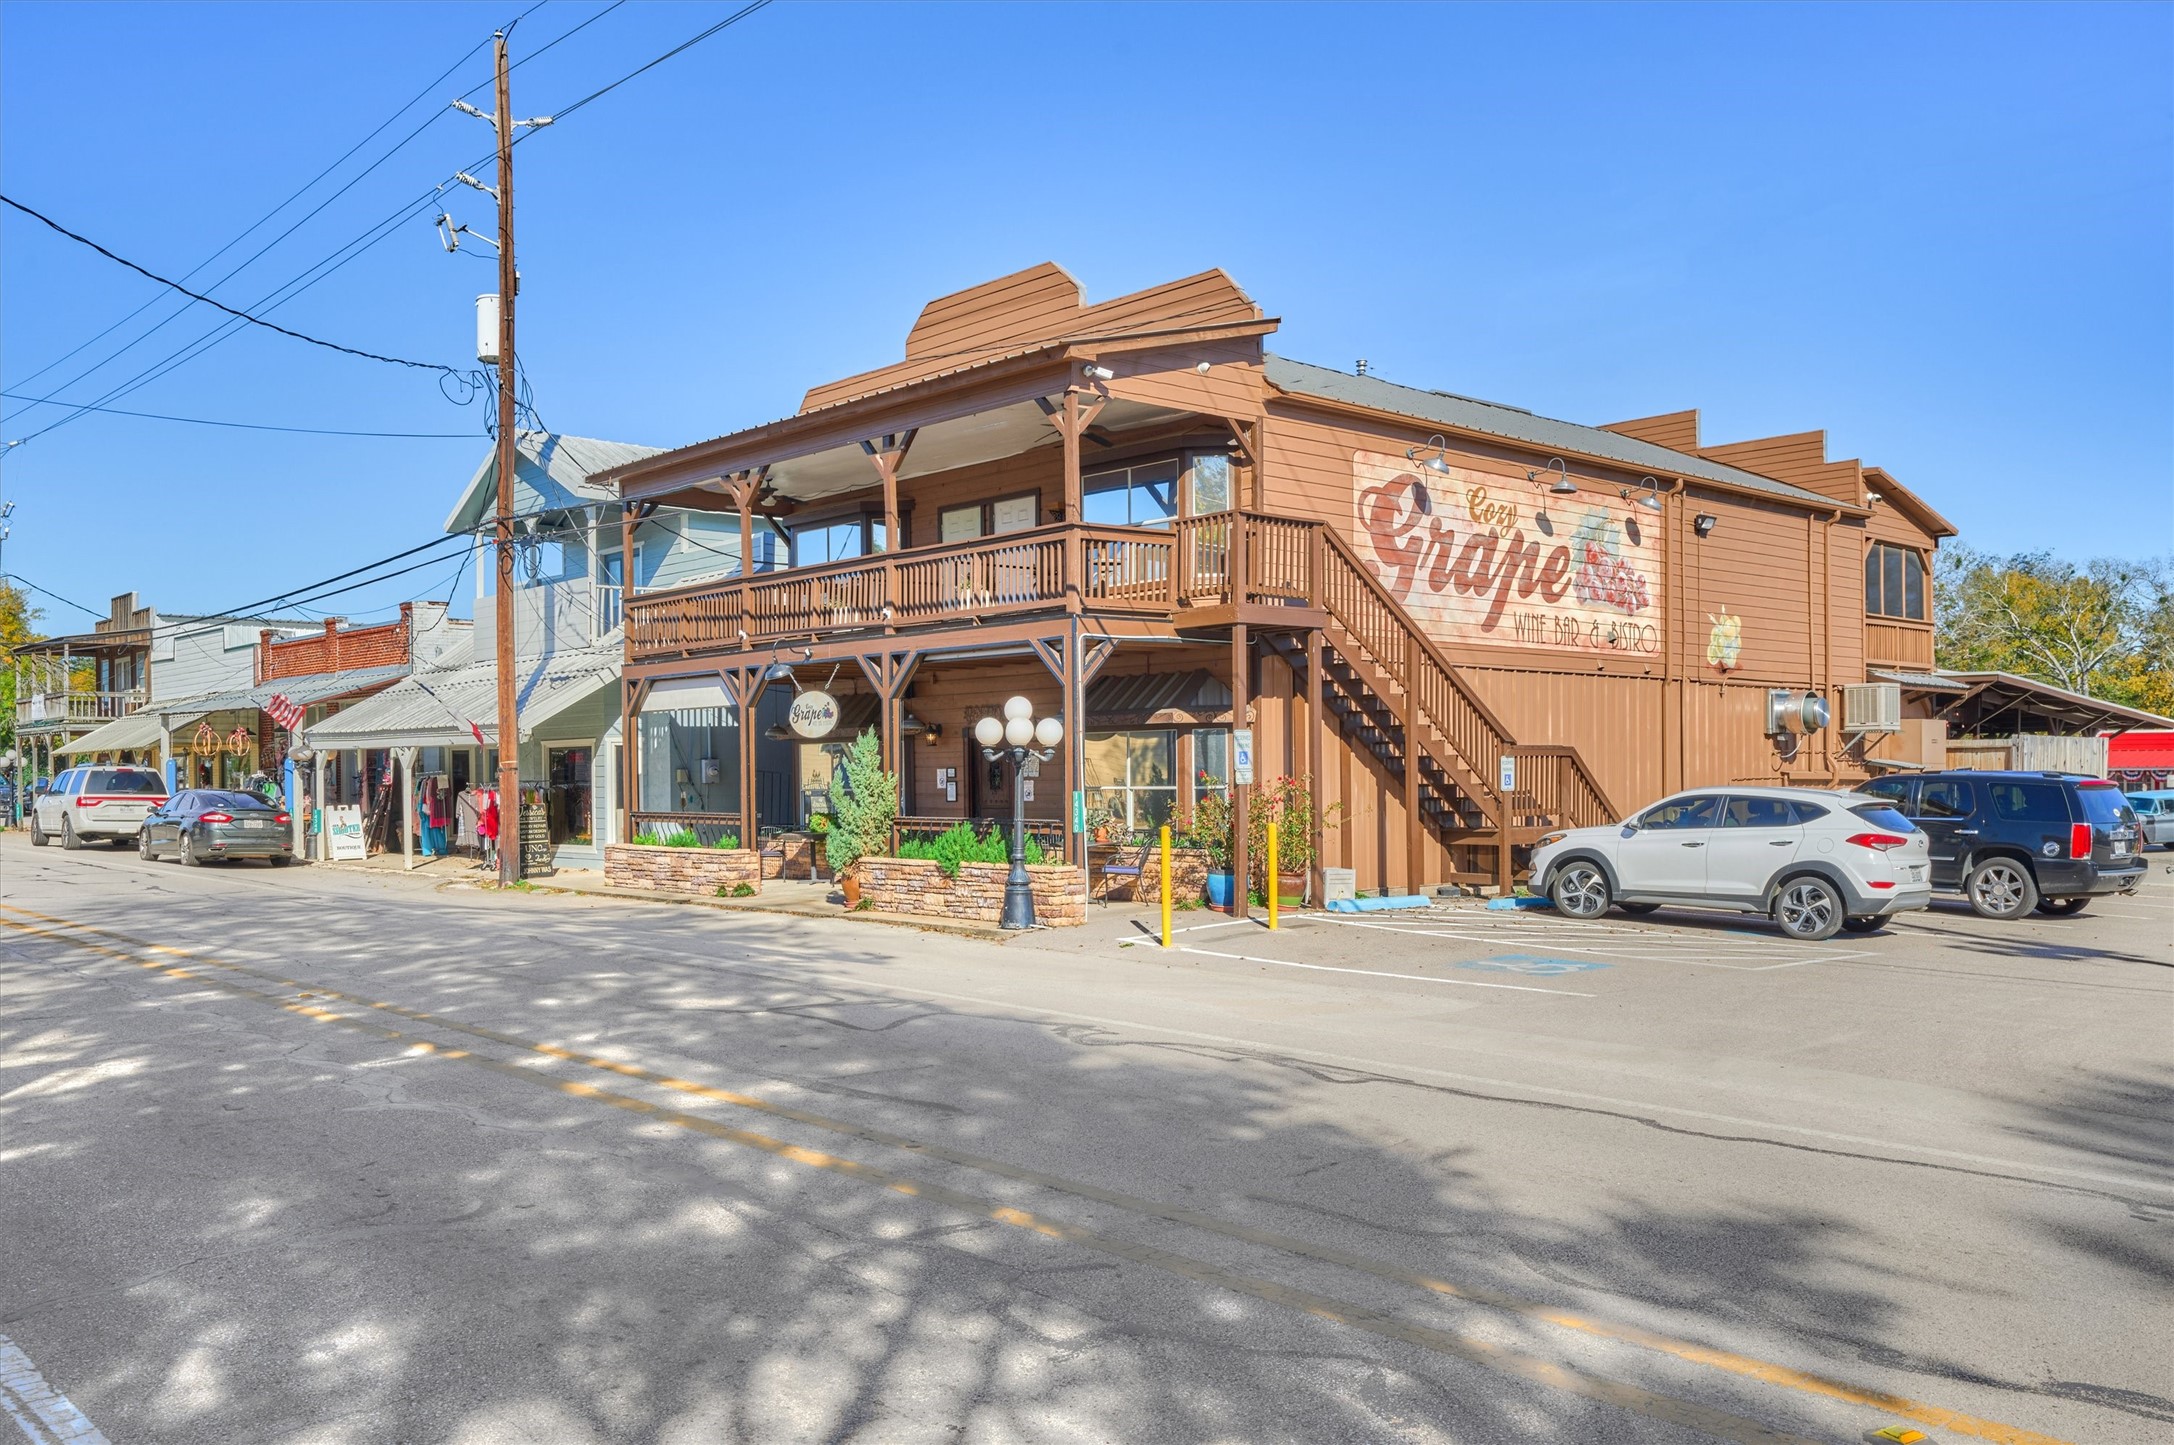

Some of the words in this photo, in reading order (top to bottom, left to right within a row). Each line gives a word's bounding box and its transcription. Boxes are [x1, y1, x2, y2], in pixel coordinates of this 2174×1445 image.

[1466, 486, 1519, 538] Cozy
[1358, 473, 1572, 633] Grape
[1513, 611, 1546, 644] WINE
[1554, 615, 1580, 647] BAR
[1589, 619, 1599, 648] &
[1609, 620, 1657, 653] BISTRO
[791, 703, 822, 727] Grape
